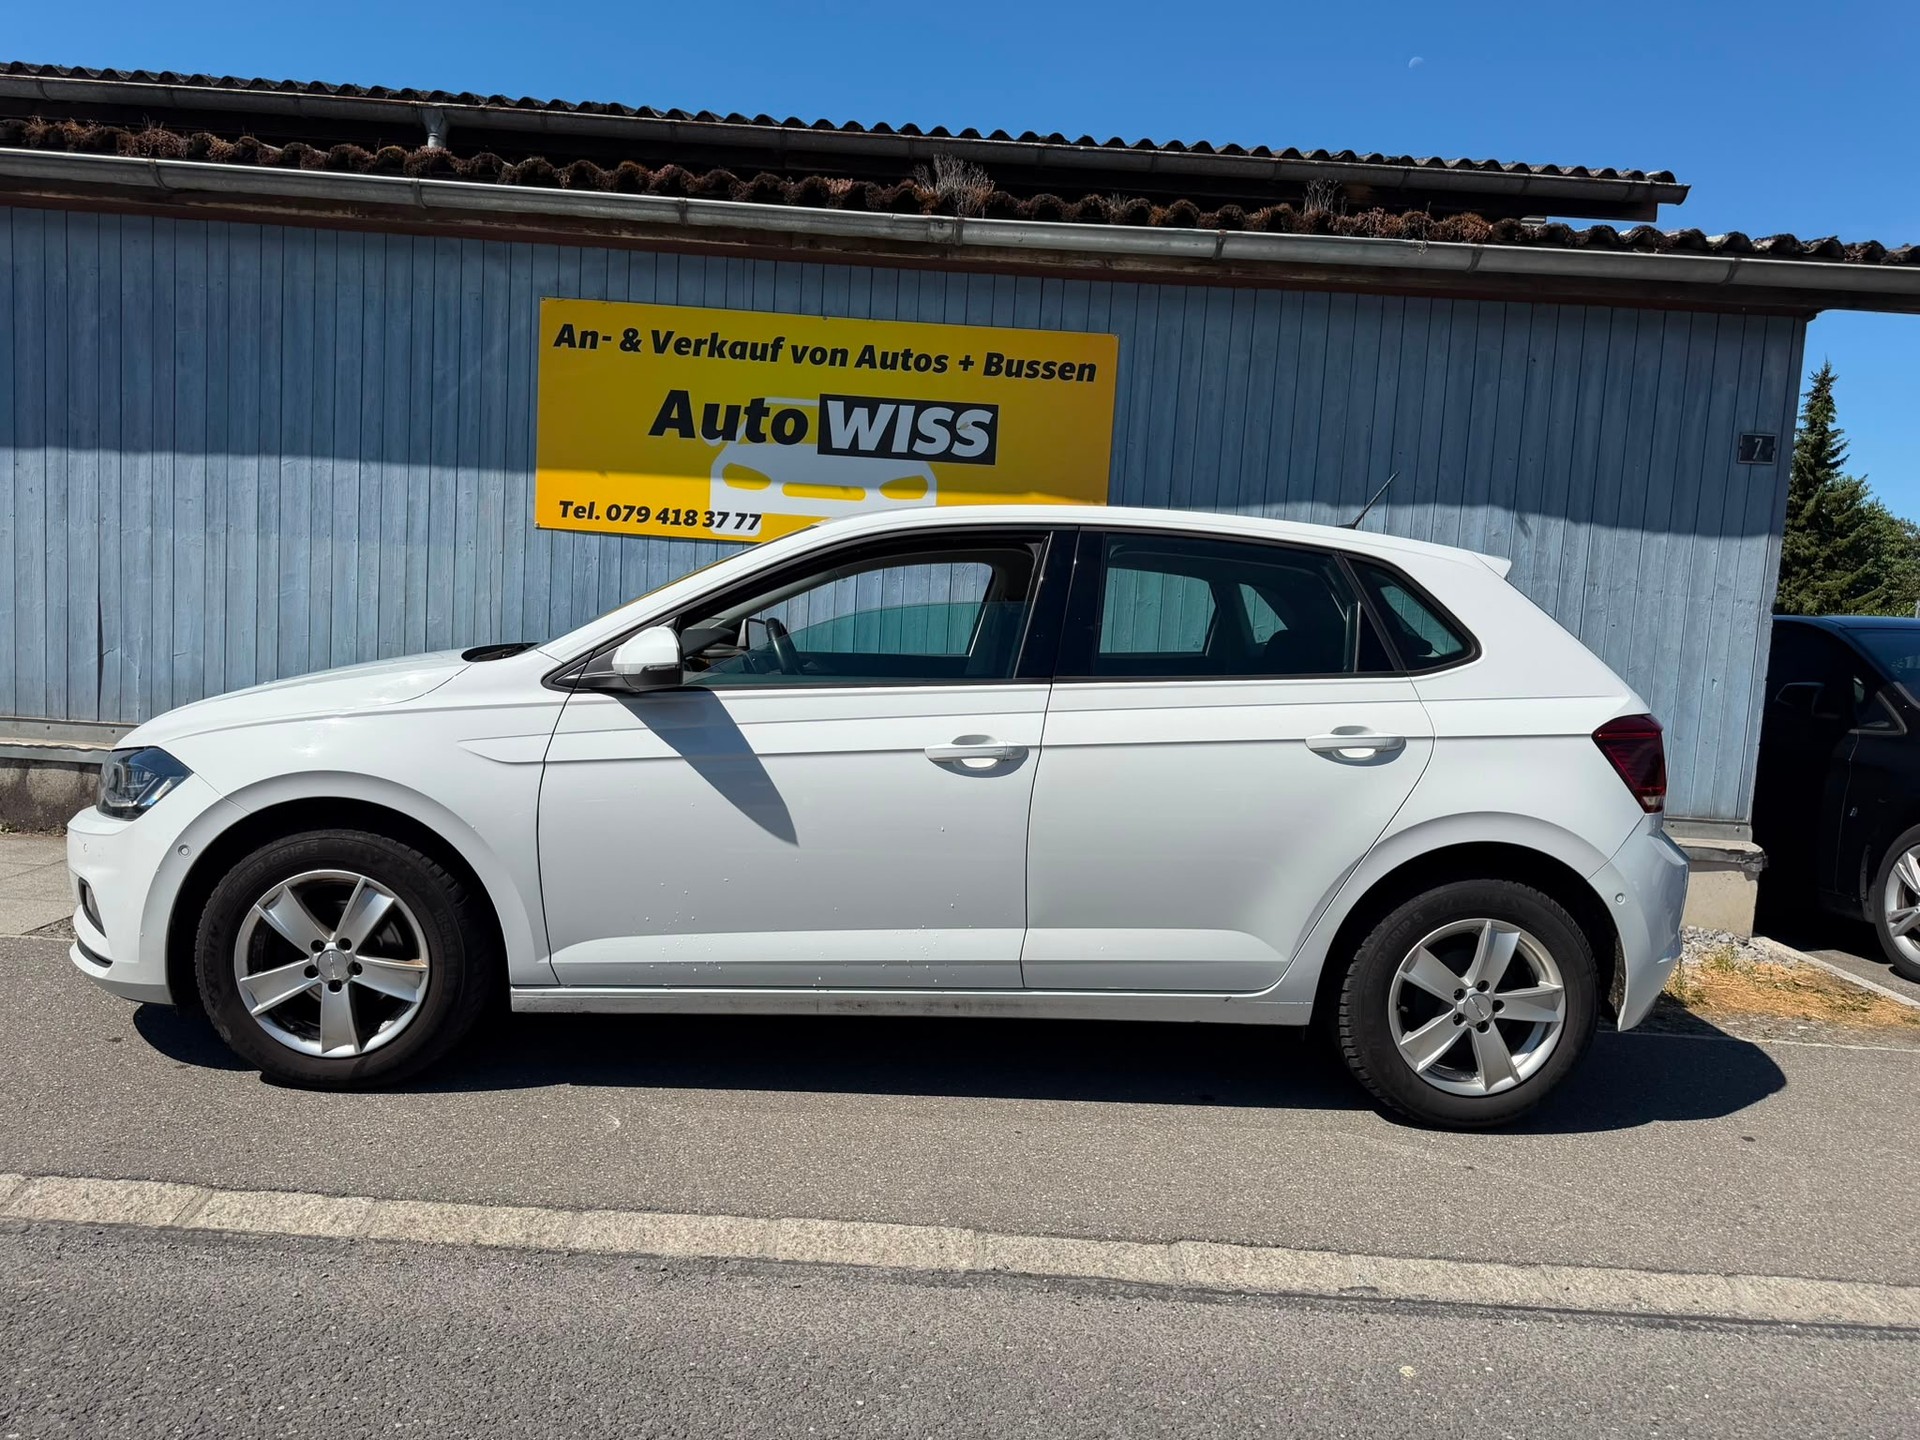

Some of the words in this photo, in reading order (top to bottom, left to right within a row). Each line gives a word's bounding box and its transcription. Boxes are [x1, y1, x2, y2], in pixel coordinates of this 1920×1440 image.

[552, 323, 613, 349] An-
[619, 327, 643, 353] &
[650, 329, 786, 366] Verkauf
[790, 344, 849, 368] von
[853, 344, 950, 374] Autos
[958, 354, 975, 372] +
[982, 351, 1097, 383] Bussen
[647, 389, 809, 446] Auto
[826, 400, 994, 458] WISS
[1752, 438, 1763, 460] 7
[559, 500, 602, 521] Tel.
[606, 504, 651, 525] 079
[655, 507, 698, 527] 418
[702, 510, 730, 528] 37
[734, 512, 762, 531] 77
[269, 845, 305, 865] GRIP
[309, 842, 319, 855] 5
[1385, 919, 1412, 948] GRIP
[1412, 911, 1424, 923] 5
